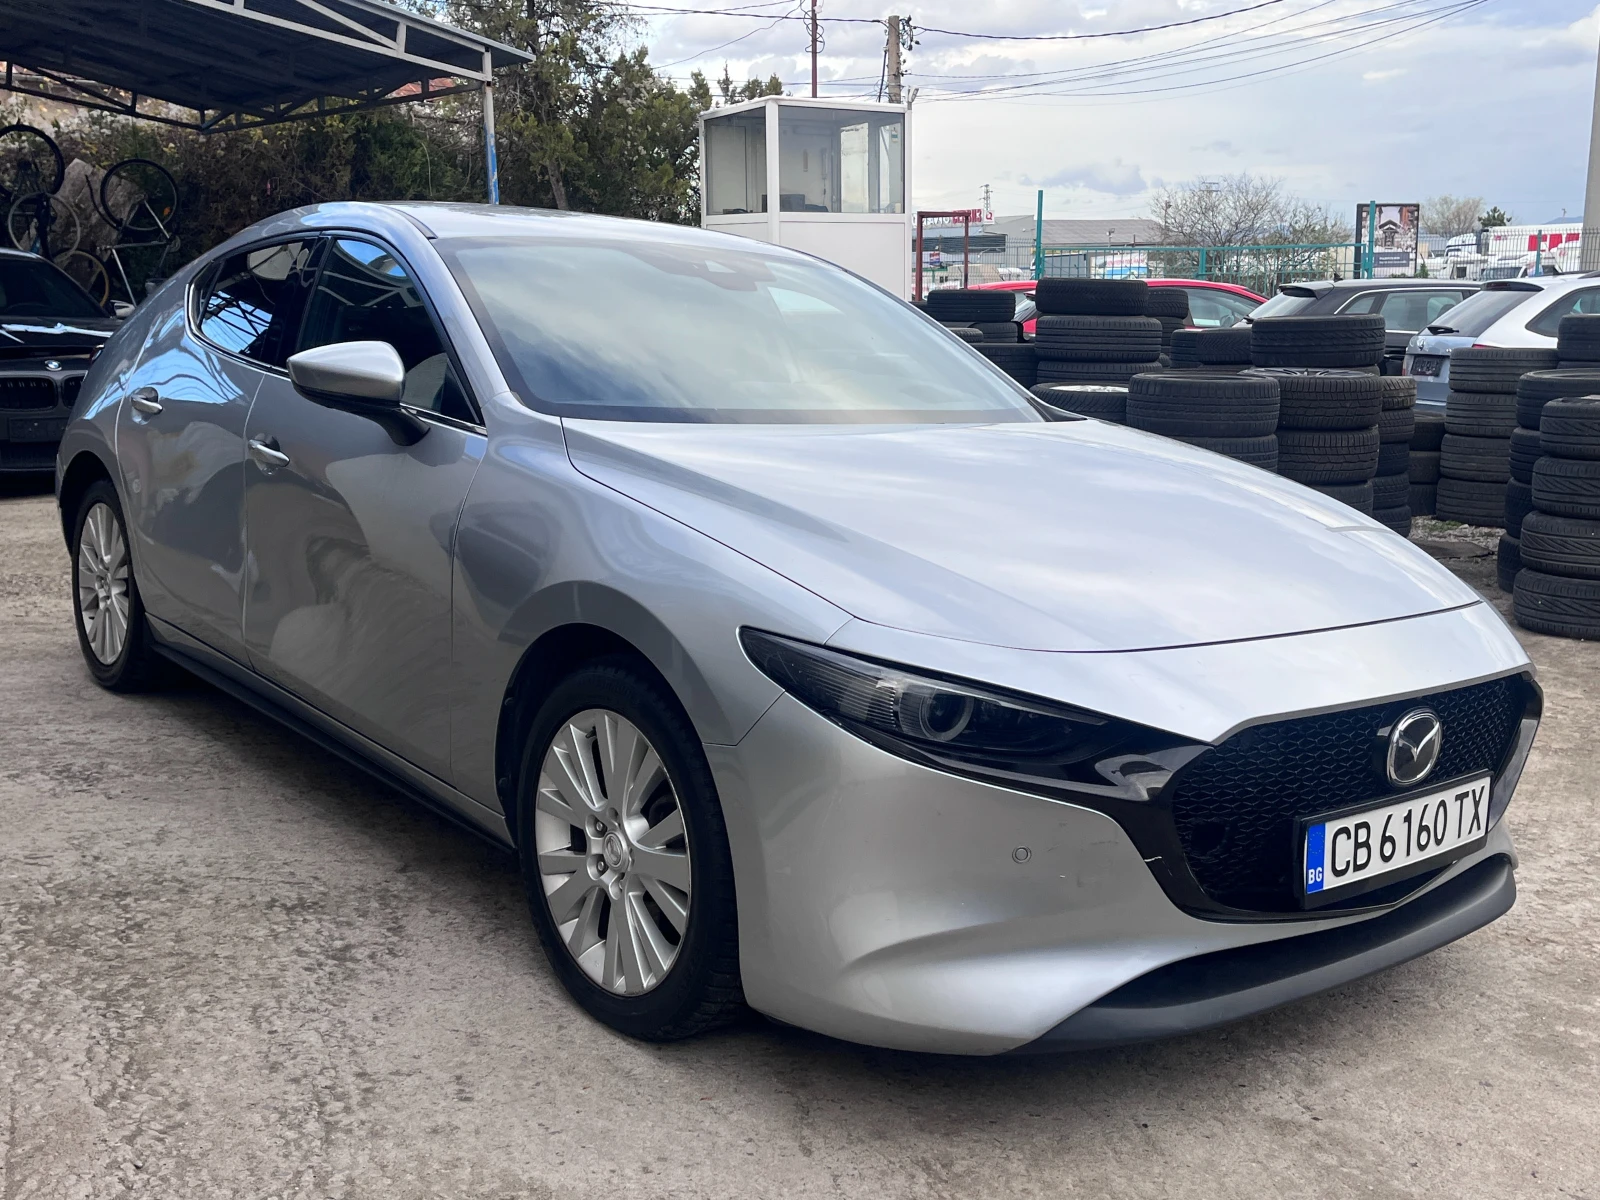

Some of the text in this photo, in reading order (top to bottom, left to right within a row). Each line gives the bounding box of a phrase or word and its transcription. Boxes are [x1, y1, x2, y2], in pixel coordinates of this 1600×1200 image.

[1331, 785, 1485, 878] CB 6160 TX
[1308, 866, 1323, 885] BG
